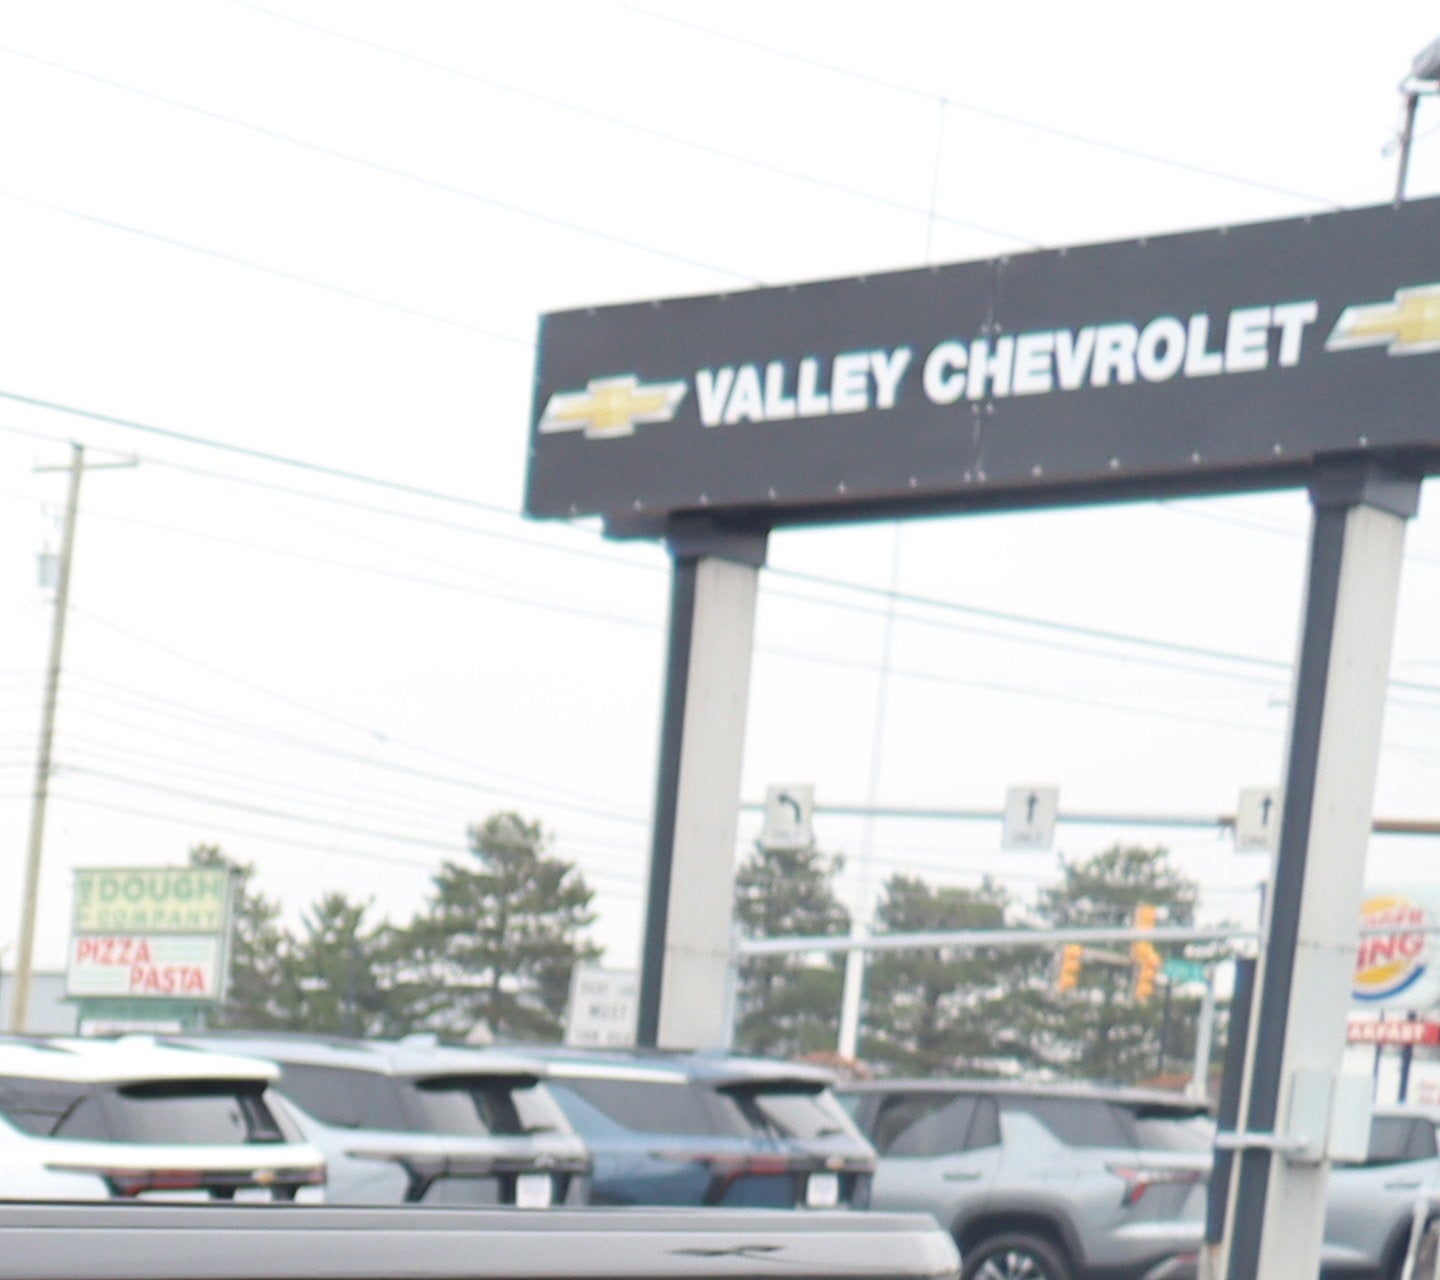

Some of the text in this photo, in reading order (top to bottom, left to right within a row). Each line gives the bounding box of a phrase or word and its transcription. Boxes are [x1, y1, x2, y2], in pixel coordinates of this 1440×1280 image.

[695, 300, 1318, 427] VALLEY CHEVROLET
[99, 877, 223, 903] DOUGH
[98, 909, 218, 925] COMPANY
[76, 937, 151, 966] PIZZA
[1356, 931, 1425, 969] ING
[129, 965, 206, 993] PASTA
